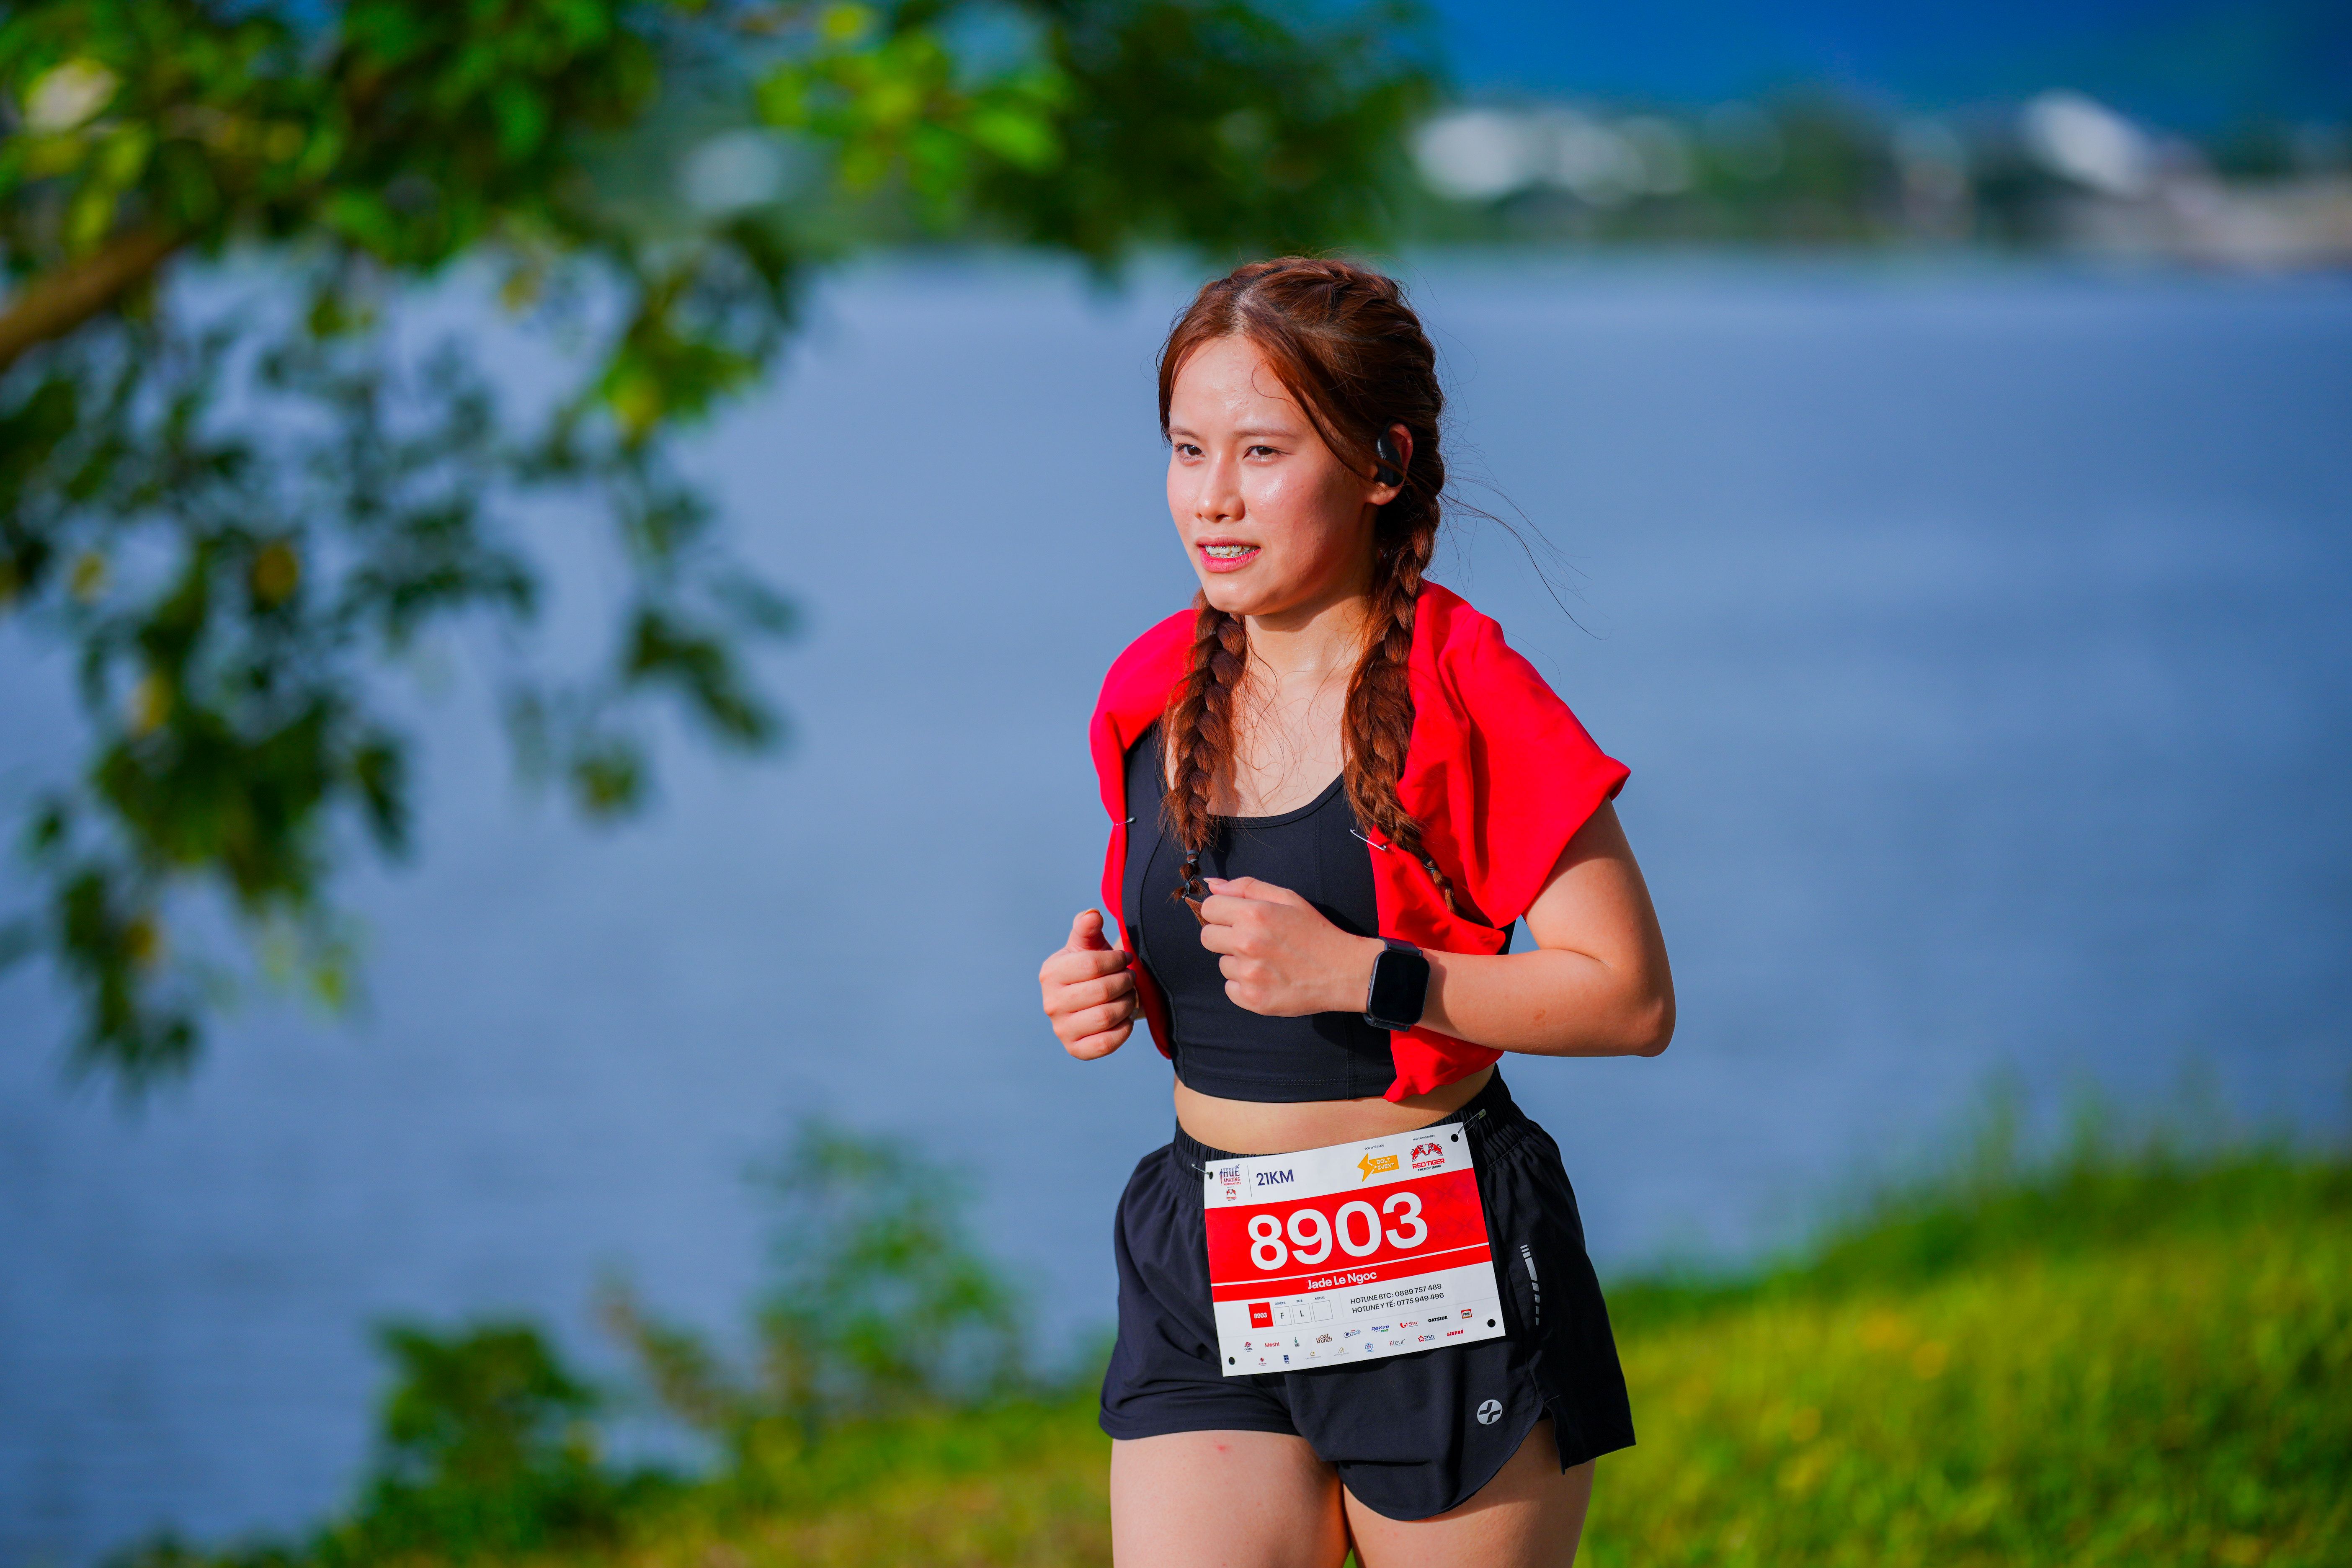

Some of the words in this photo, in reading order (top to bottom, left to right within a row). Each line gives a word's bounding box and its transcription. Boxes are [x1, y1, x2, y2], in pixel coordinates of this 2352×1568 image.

[1256, 1169, 1294, 1186] 21KM
[1248, 1192, 1428, 1271] 8903
[1308, 1278, 1332, 1289] Jade
[1333, 1276, 1346, 1285] Le
[1347, 1272, 1377, 1284] Ngoc
[1351, 1295, 1378, 1304] HOTLINE
[1395, 1289, 1413, 1297] 0889
[1352, 1304, 1380, 1313] HOTLINE
[1396, 1298, 1414, 1306] 0775
